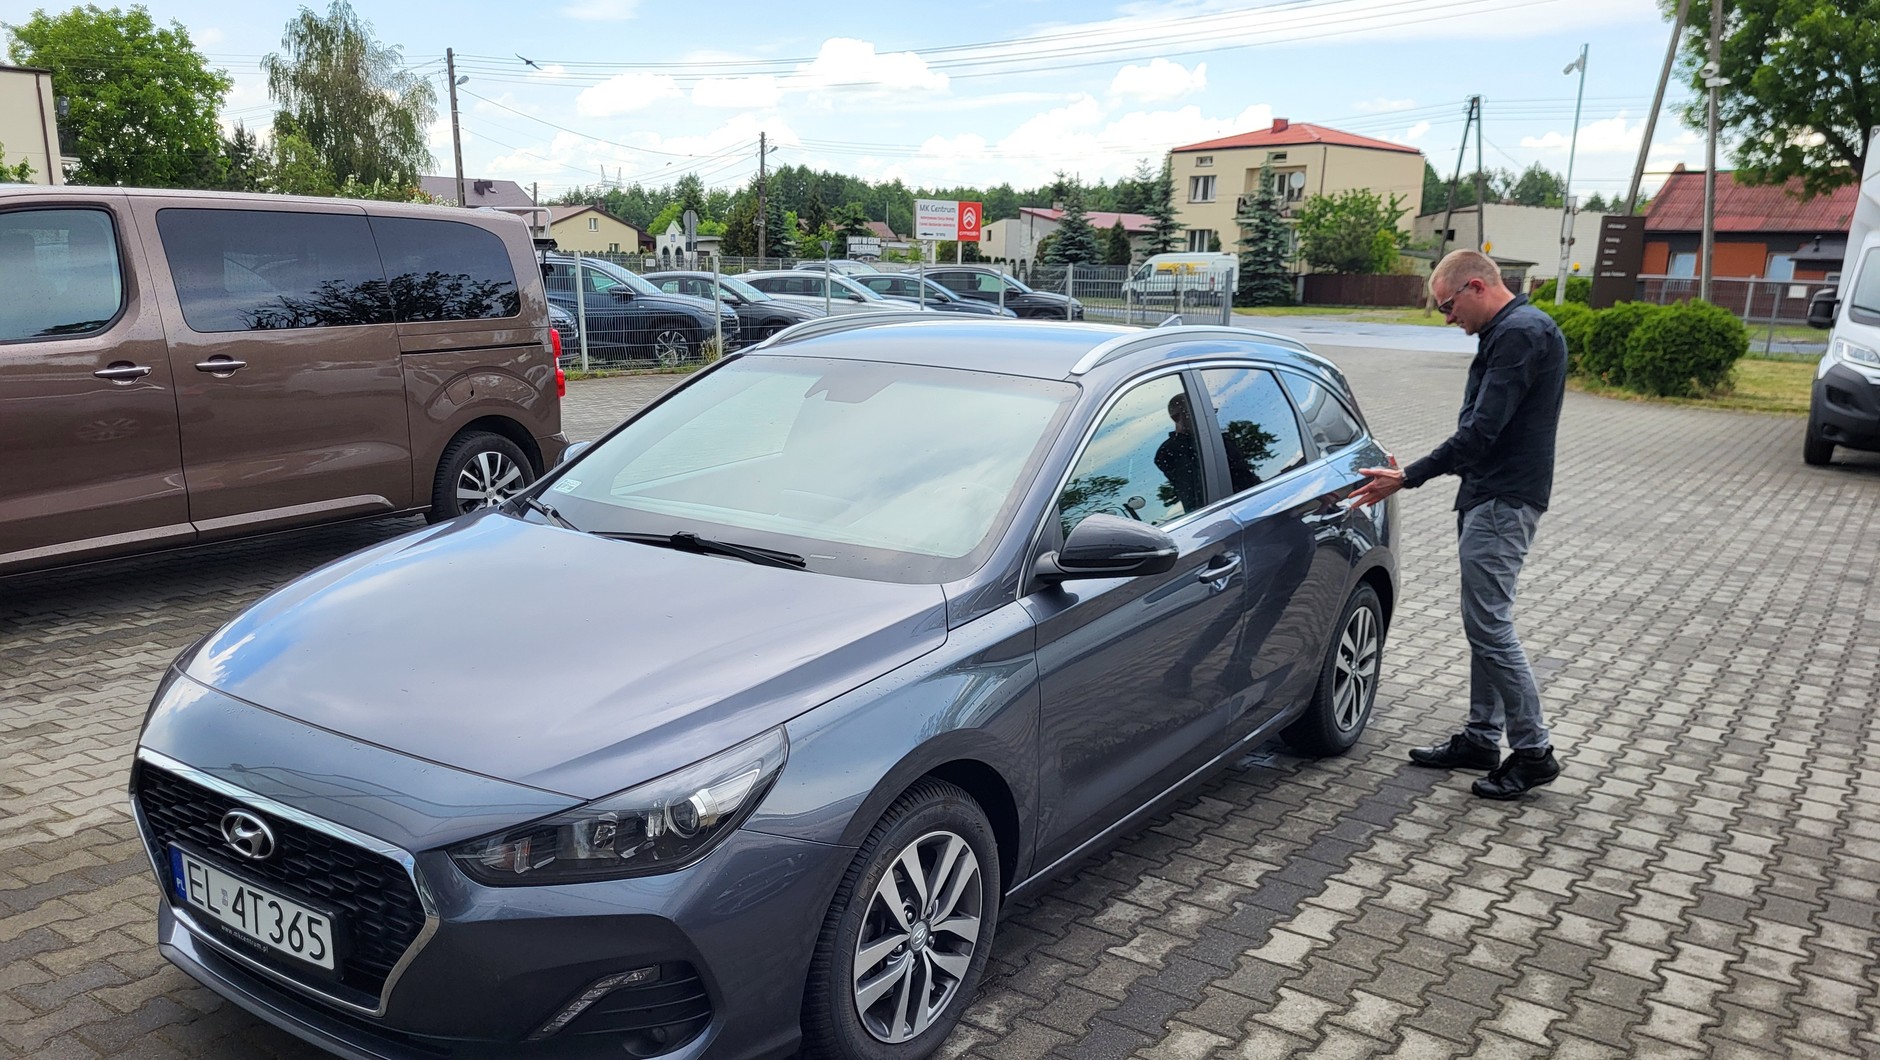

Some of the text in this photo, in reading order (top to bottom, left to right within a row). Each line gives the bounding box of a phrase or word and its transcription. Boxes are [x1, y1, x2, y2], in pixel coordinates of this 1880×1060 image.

[919, 204, 956, 213] MK Centrum
[176, 877, 185, 891] PL
[187, 859, 325, 960] EL 4T365
[221, 925, 269, 953] www.mkcentrum.pl
